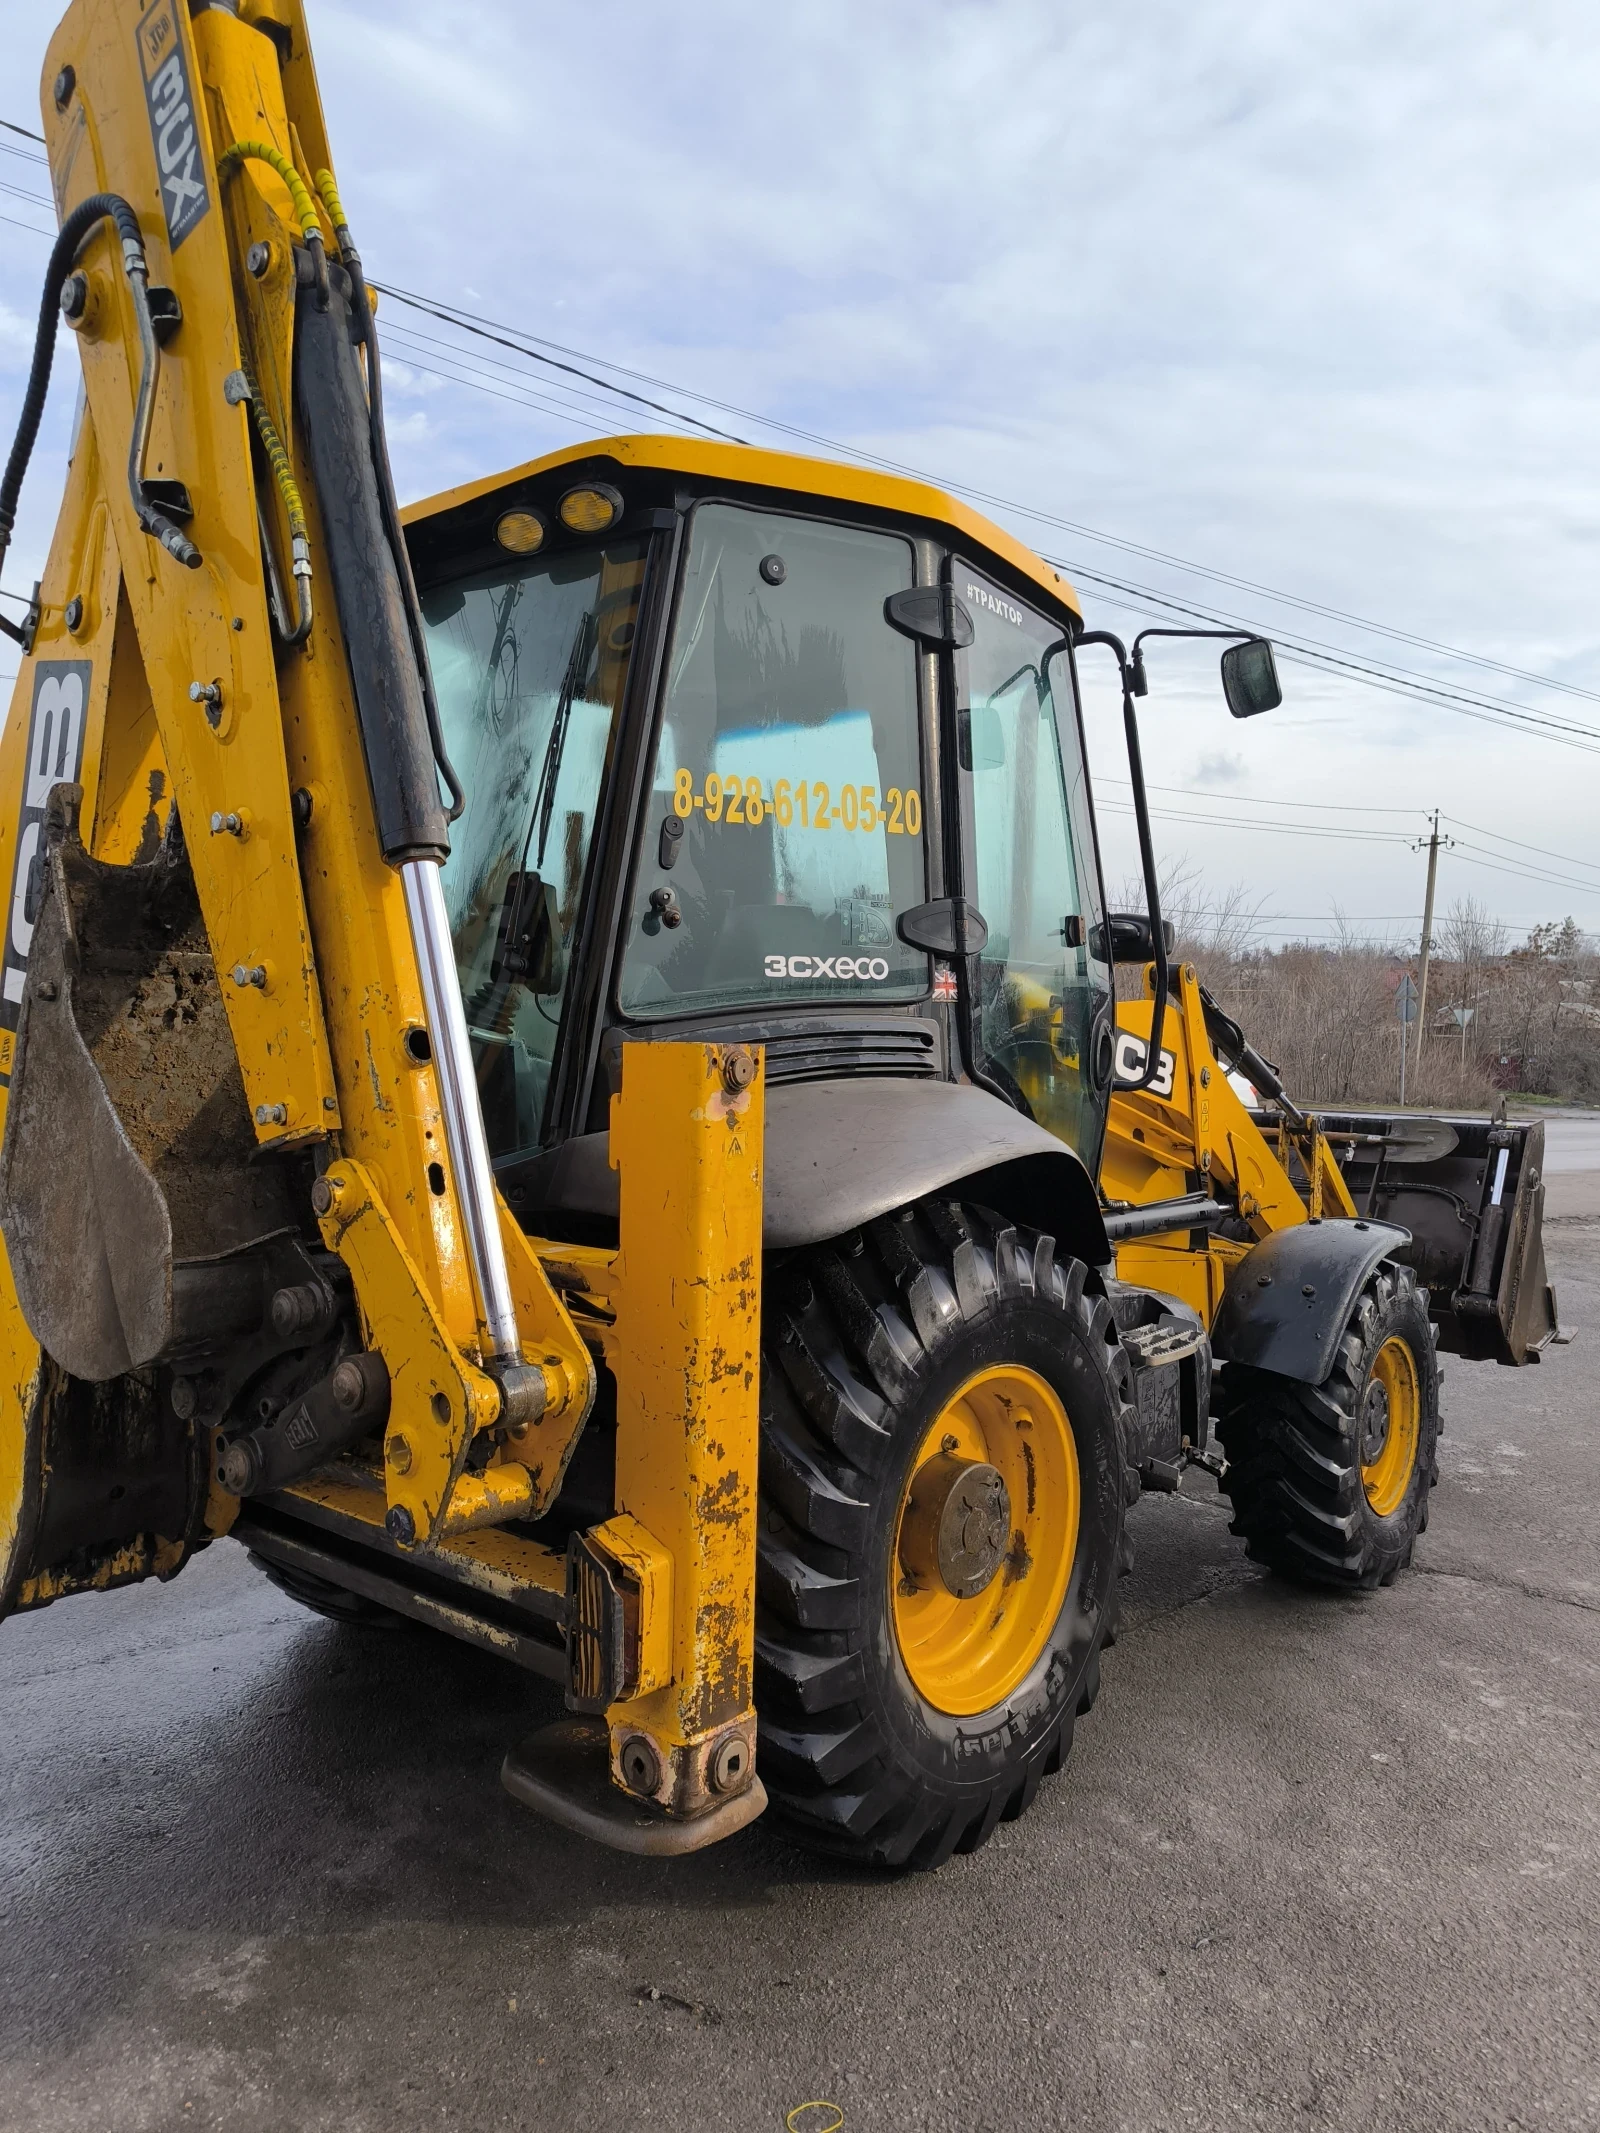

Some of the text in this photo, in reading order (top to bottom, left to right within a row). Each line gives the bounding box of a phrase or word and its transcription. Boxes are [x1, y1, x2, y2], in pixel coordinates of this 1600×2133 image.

[149, 17, 170, 55] JCB
[151, 54, 205, 230] 3CX
[673, 767, 922, 836] 8-928-612-05-20
[1115, 1034, 1174, 1095] CB
